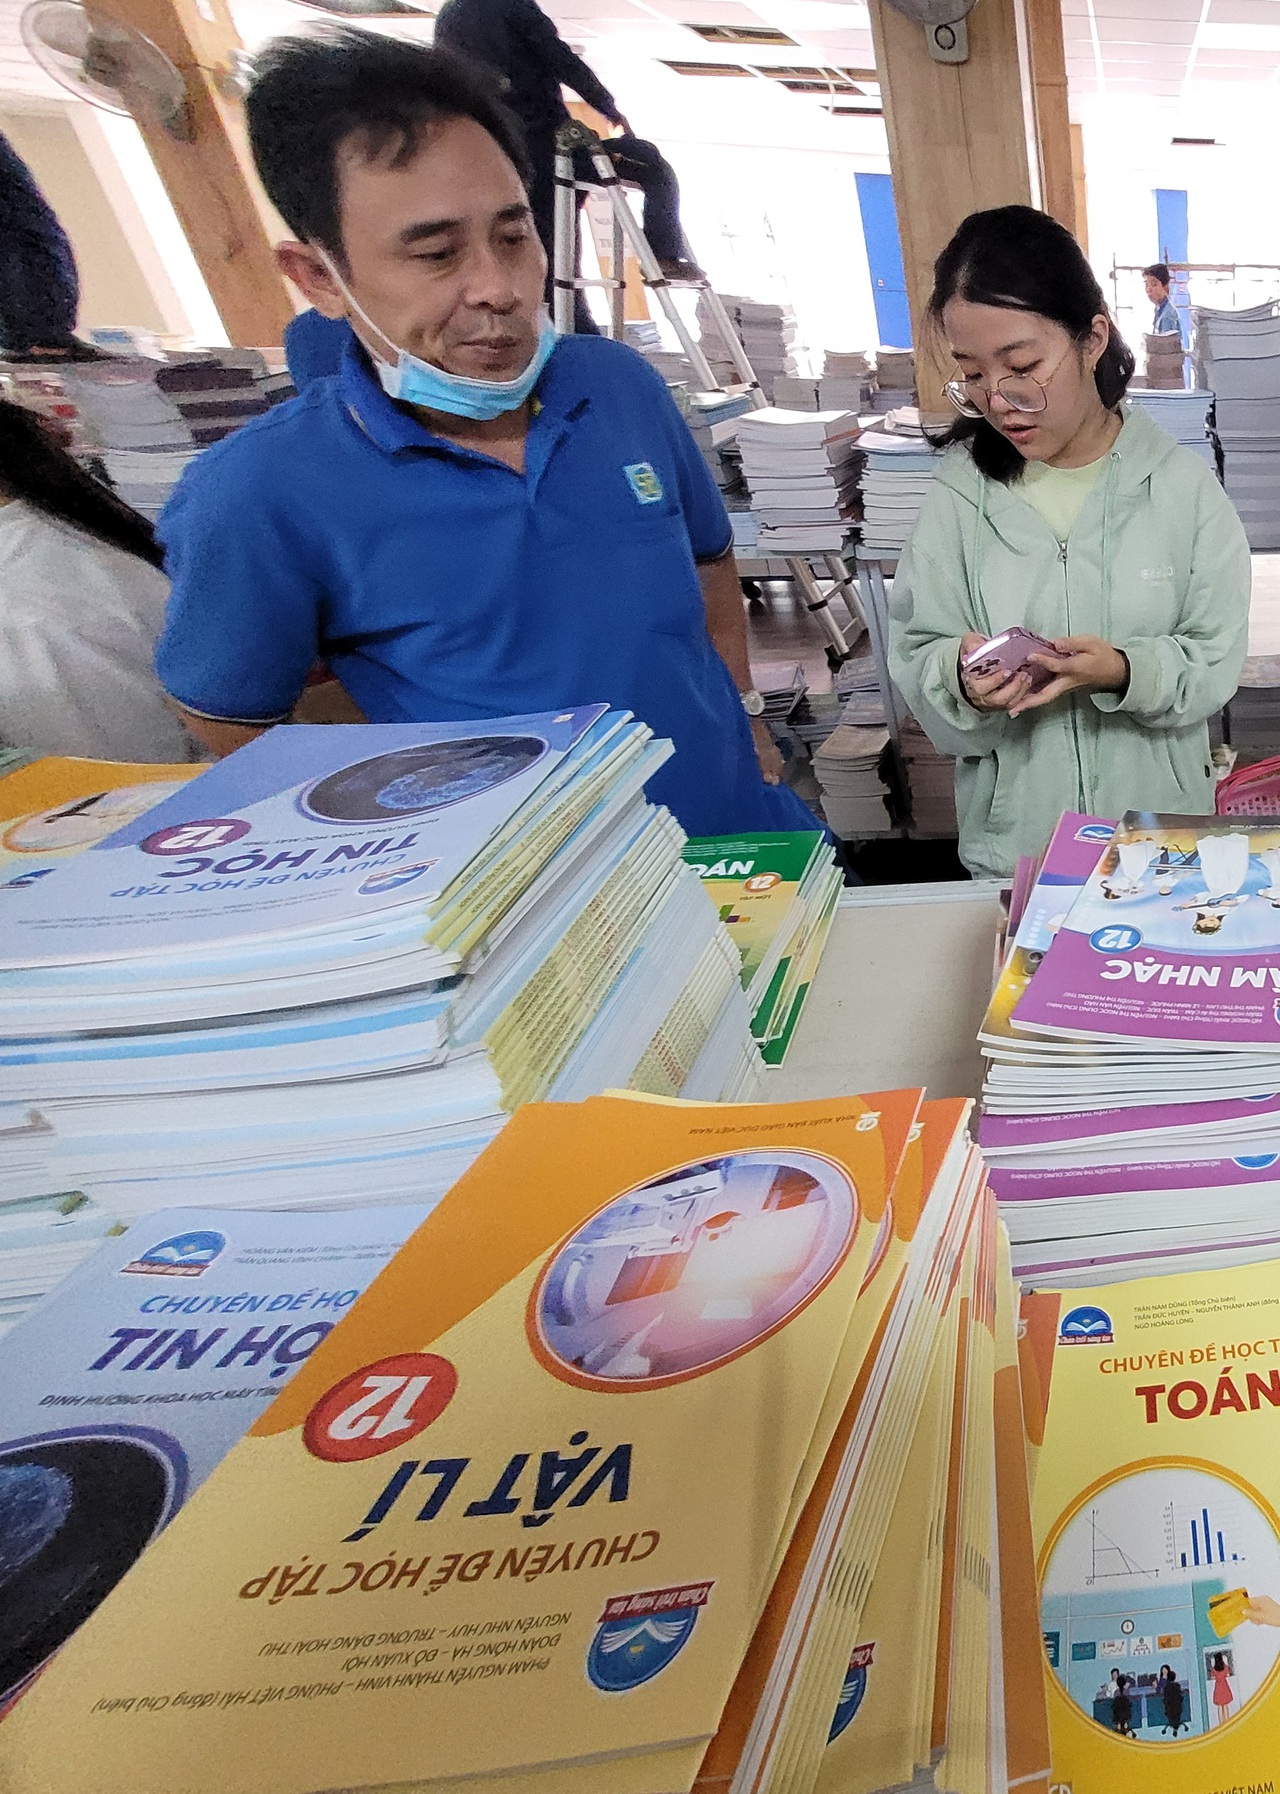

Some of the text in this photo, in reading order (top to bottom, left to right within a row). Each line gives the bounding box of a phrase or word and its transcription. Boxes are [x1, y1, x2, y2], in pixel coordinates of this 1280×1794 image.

[158, 825, 237, 849] 12
[157, 831, 420, 878] TIN HỌC
[293, 853, 407, 881] CHUYÊN
[689, 859, 755, 877] OÁN
[110, 882, 171, 898] TẬP
[174, 878, 245, 894] HỌC
[750, 875, 776, 889] 12
[1098, 929, 1133, 950] 12
[1099, 957, 1222, 987] NHẠC
[139, 1287, 360, 1315] CHUYÊN ĐỀ HỌ
[1134, 1295, 1236, 1313] TRẦN NAM DŨNG (Tổng Chủ biên)
[1134, 1312, 1151, 1321] TRẦN
[1151, 1309, 1168, 1320] ĐỨC
[1168, 1308, 1190, 1319] HUYÊN
[1195, 1305, 1223, 1316] NGUYỄN
[1222, 1302, 1246, 1313] THÀNH
[1246, 1300, 1260, 1310] ANH
[1260, 1297, 1280, 1309] (đồng
[1134, 1316, 1195, 1330] NGÔ HOÀNG LONG
[86, 1320, 335, 1378] TIN HỌ
[1099, 1348, 1184, 1375] CHUYÊN
[1189, 1342, 1219, 1365] ĐỀ
[1222, 1340, 1267, 1363] HỌC
[38, 1394, 83, 1408] ĐỊNH
[187, 1390, 222, 1403] HỌC
[328, 1375, 431, 1441] 12
[341, 1431, 633, 1543] VẬT LÍ
[237, 1529, 661, 1606] CHUYÊN ĐỀ HỌC TẬP
[448, 1621, 480, 1639] HUY
[478, 1618, 511, 1637] NHƯ
[514, 1611, 571, 1631] NGUYỄN
[294, 1638, 331, 1657] HOÀI
[379, 1627, 437, 1648] TRƯƠNG
[258, 1641, 292, 1658] THU
[340, 1632, 561, 1673] ĐOÀN HỒNG HÀ ĐỖ XUÂN HỘI
[90, 1656, 550, 1715] PHẠM NGUYỄN THÀNH VINH PHÙNG VIỆT HẢI (đồng Chủ biên)
[1247, 1781, 1274, 1794] NAM
